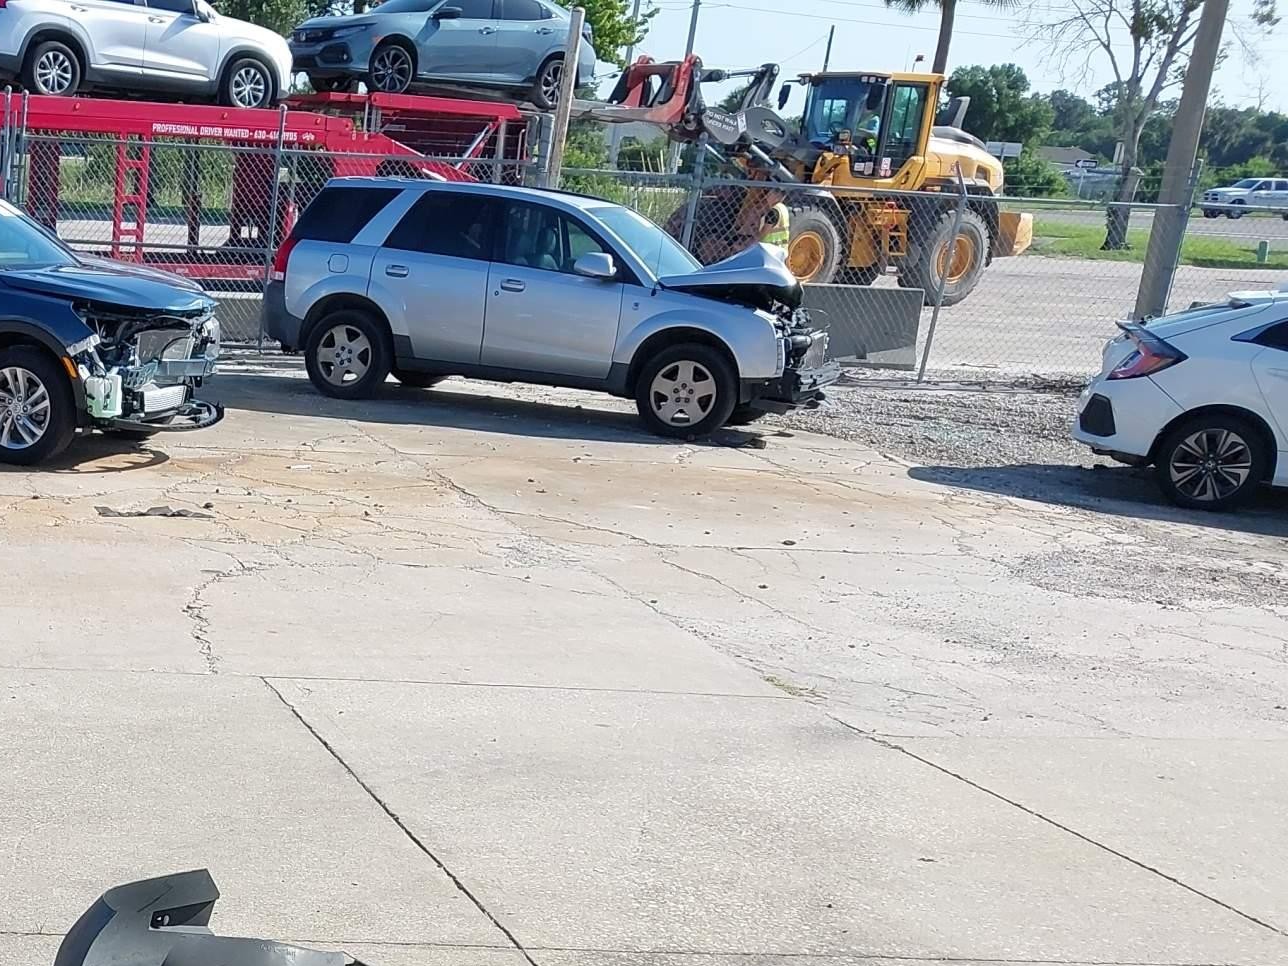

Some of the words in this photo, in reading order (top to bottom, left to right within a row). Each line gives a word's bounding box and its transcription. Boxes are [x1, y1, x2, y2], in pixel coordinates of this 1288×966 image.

[152, 123, 199, 135] PROFFESIONAL
[199, 125, 223, 136] DRIVER
[223, 127, 250, 139] WANTED
